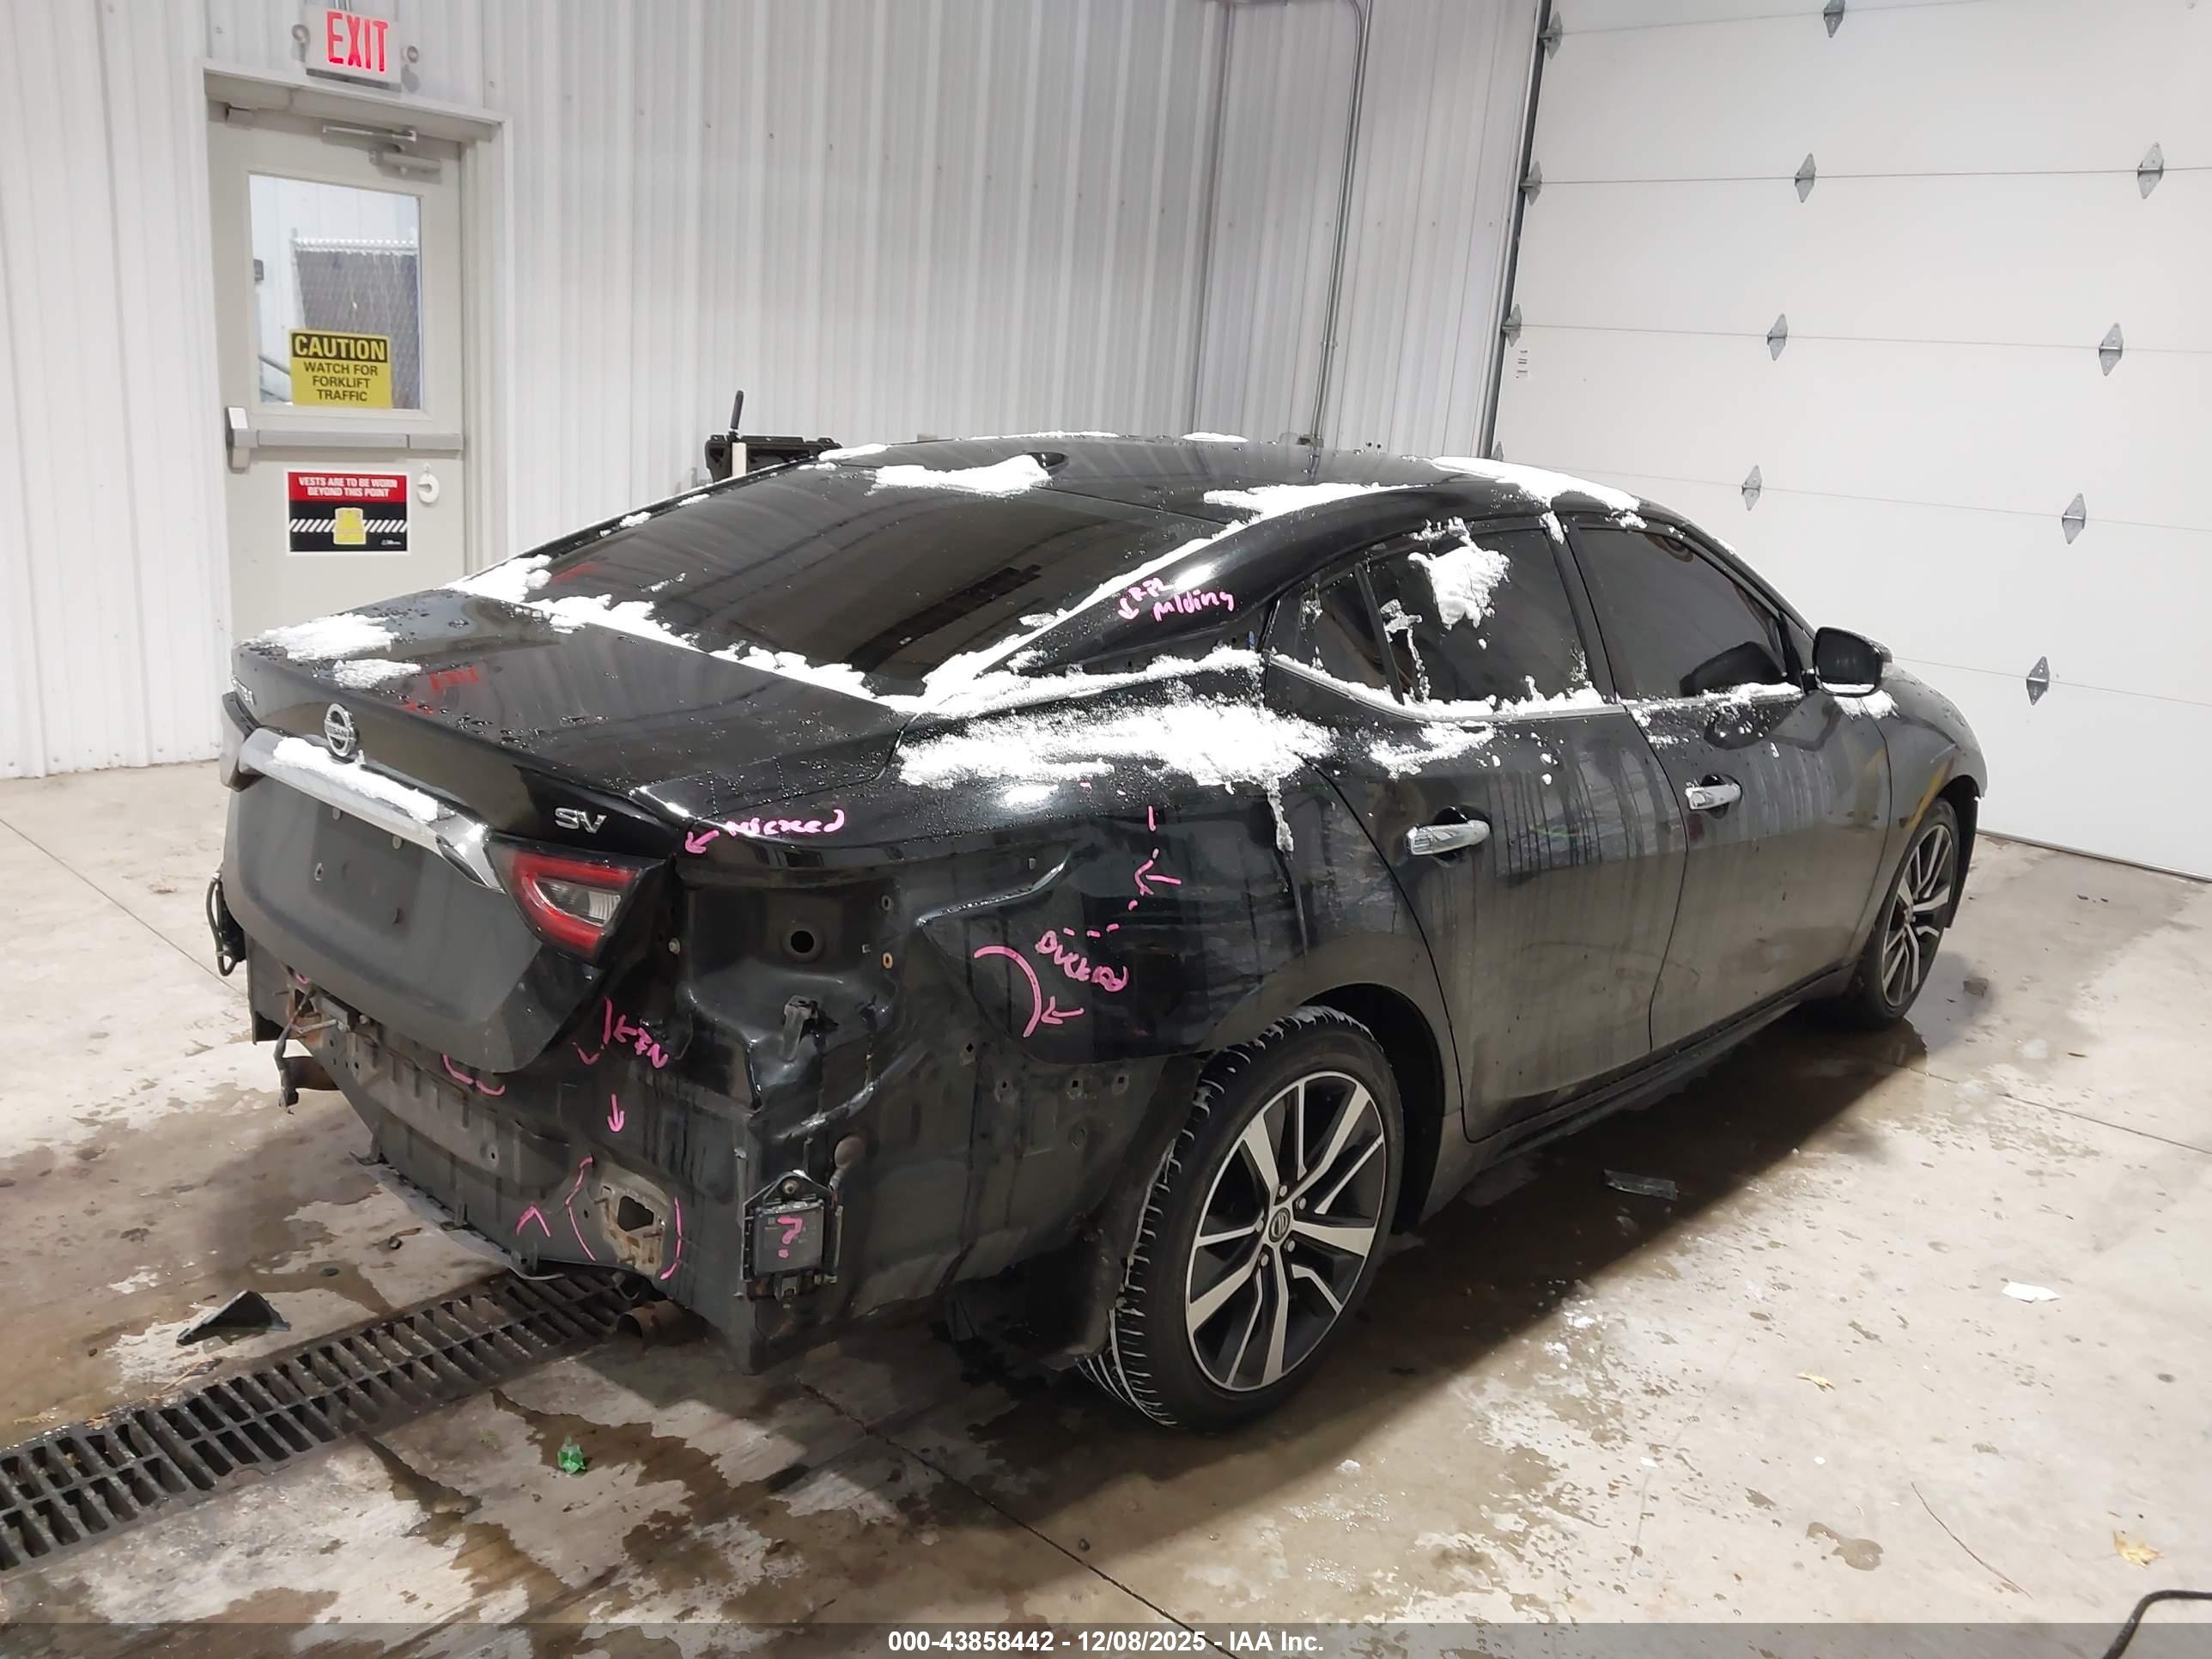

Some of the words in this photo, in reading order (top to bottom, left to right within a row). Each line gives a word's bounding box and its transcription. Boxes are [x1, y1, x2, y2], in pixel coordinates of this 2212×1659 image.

[326, 10, 389, 72] EXIT
[295, 335, 386, 361] CAUTION
[303, 361, 350, 374] WATCH
[353, 364, 379, 376] FOR
[312, 375, 371, 389] FORKLIFT
[316, 388, 368, 402] TRAFFIC
[298, 477, 327, 486] VESTS
[327, 477, 344, 487] ARE
[345, 478, 358, 487] TO
[358, 478, 370, 488] BE
[307, 487, 343, 496] BEYOND
[343, 488, 363, 497] THIS
[364, 489, 391, 497] POINT
[554, 806, 607, 835] SV
[777, 1214, 803, 1259] ?
